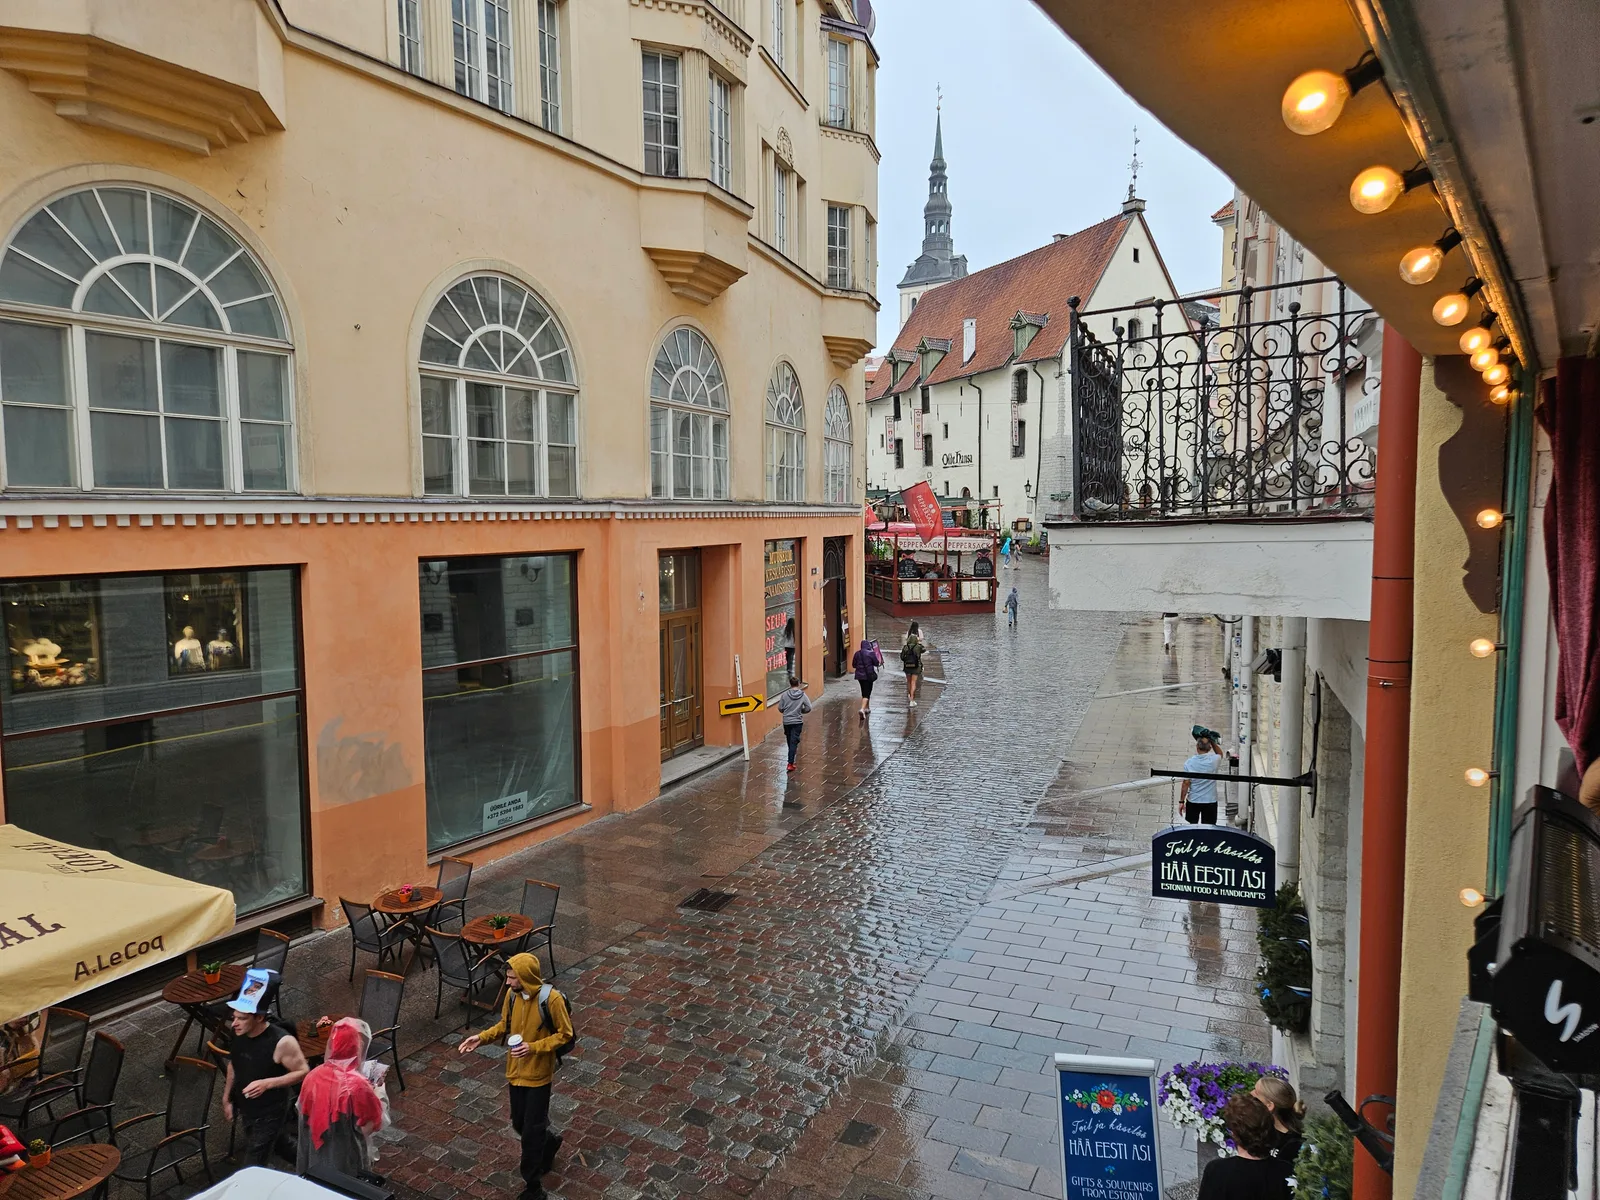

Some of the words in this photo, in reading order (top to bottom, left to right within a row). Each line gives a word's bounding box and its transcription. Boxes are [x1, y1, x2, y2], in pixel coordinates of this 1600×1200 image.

[900, 541, 942, 549] PEPPERSACK
[948, 541, 991, 549] PEPPERSACK
[766, 611, 787, 632] SEUM
[766, 635, 775, 653] OF
[765, 651, 788, 673] TURE
[1193, 842, 1211, 858] ja
[1161, 861, 1191, 882] HÄÄ
[1194, 865, 1235, 887] EESTI
[1240, 870, 1266, 890] ASI
[1160, 882, 1192, 893] ESTONIAN
[1193, 886, 1212, 895] FOOD
[1212, 888, 1219, 896] &
[1220, 889, 1266, 900] HANDICRAFTS
[0, 913, 66, 950] AL
[1093, 1119, 1106, 1134] ja
[1069, 1138, 1093, 1157] HÄÄ
[1095, 1141, 1128, 1160] EESTI
[1132, 1144, 1151, 1162] ASI
[1071, 1175, 1095, 1188] GIFTS
[1096, 1178, 1103, 1189] &
[1105, 1179, 1154, 1193] SOUVENIRS
[1082, 1187, 1107, 1199] FROM
[1108, 1189, 1144, 1200] ESTONIA
